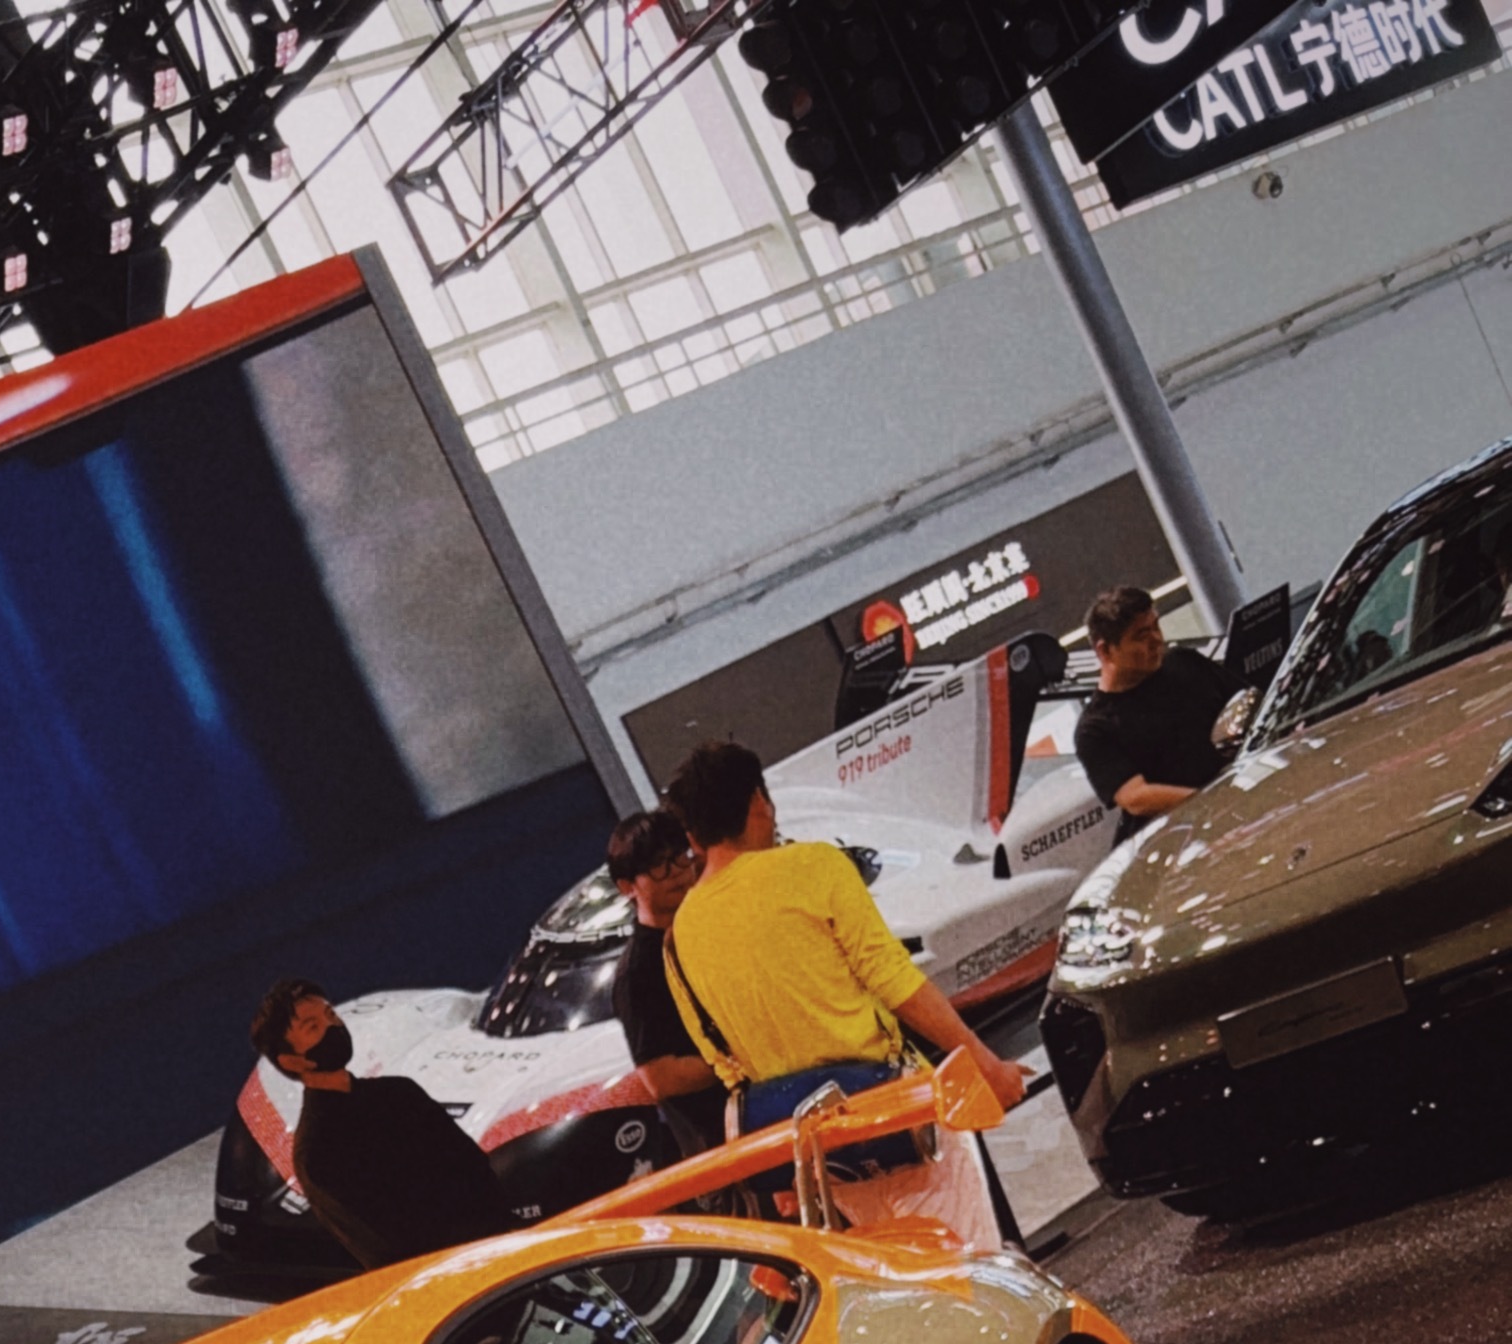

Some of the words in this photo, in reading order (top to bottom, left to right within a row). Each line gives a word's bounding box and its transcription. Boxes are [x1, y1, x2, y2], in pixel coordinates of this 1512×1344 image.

[1153, 44, 1307, 150] CATL
[1290, 0, 1465, 96] 宁德时代
[835, 676, 965, 759] PORSCHE
[838, 760, 864, 787] 919
[867, 734, 911, 773] tribute
[1021, 805, 1105, 860] SCHAEFFLER
[434, 1050, 541, 1061] CHOPARD
